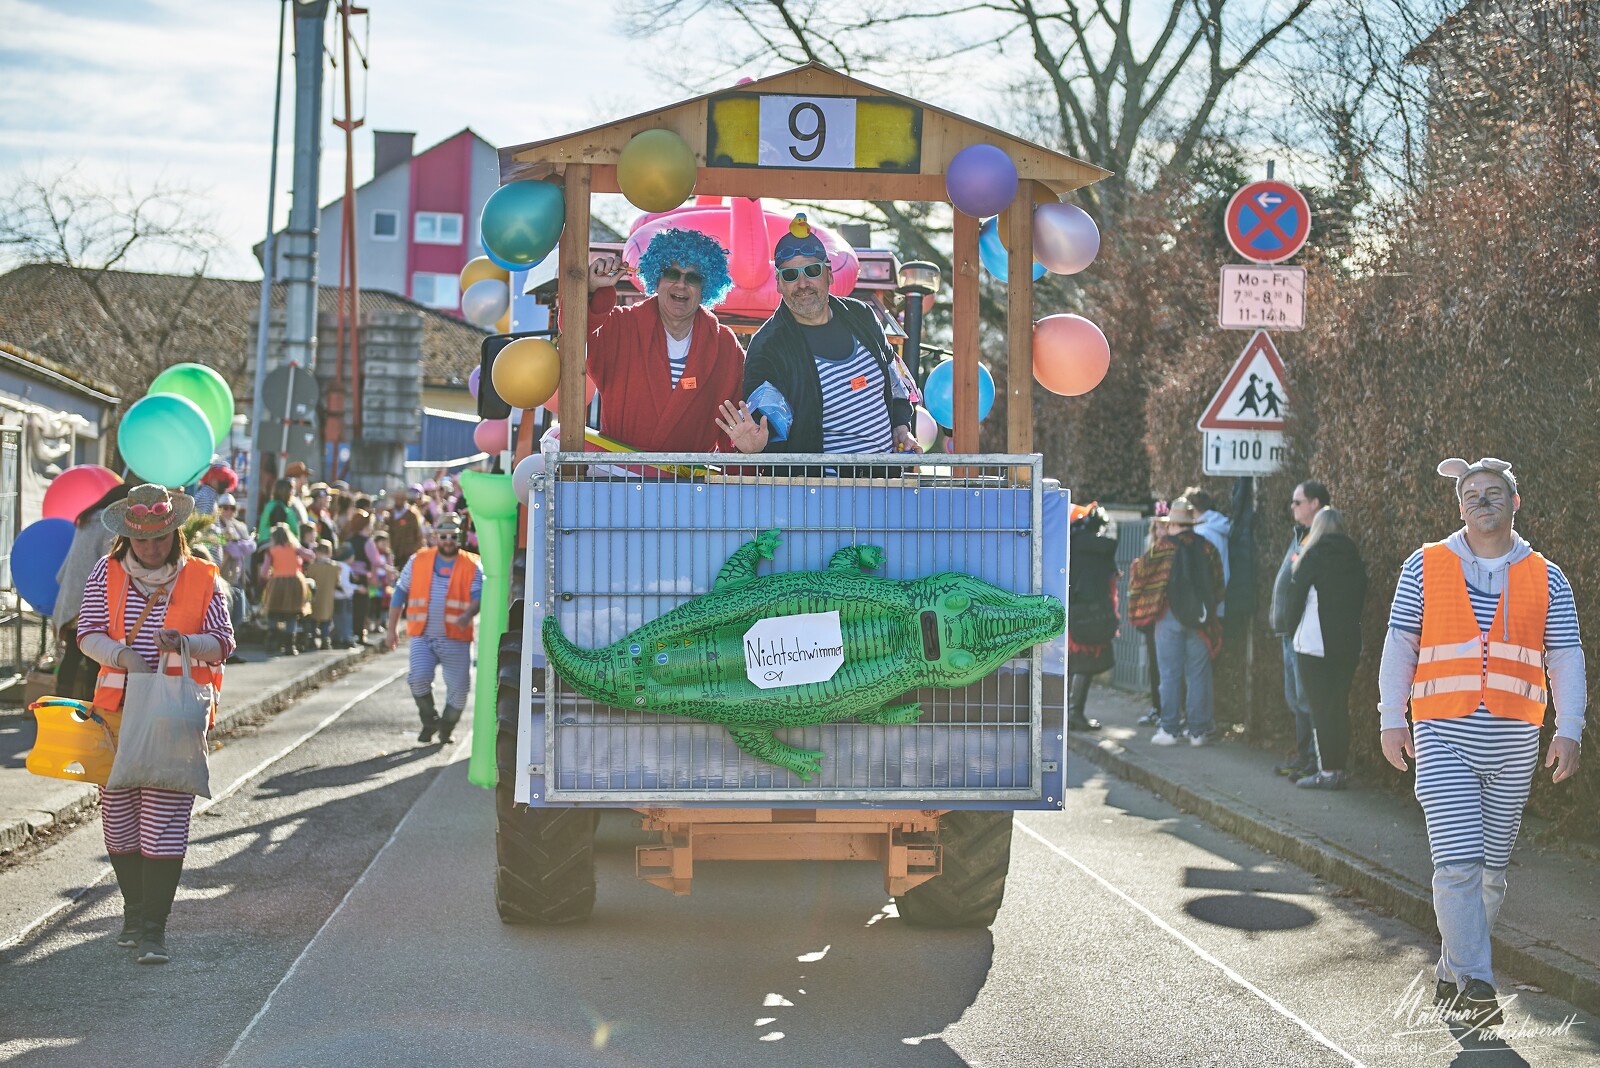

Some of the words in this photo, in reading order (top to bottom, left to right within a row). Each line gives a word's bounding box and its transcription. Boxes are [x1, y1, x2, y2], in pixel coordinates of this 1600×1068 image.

[788, 102, 826, 162] 9
[1238, 273, 1259, 286] Mo
[1232, 440, 1262, 460] 100
[746, 636, 843, 669] Nichtschwimmer
